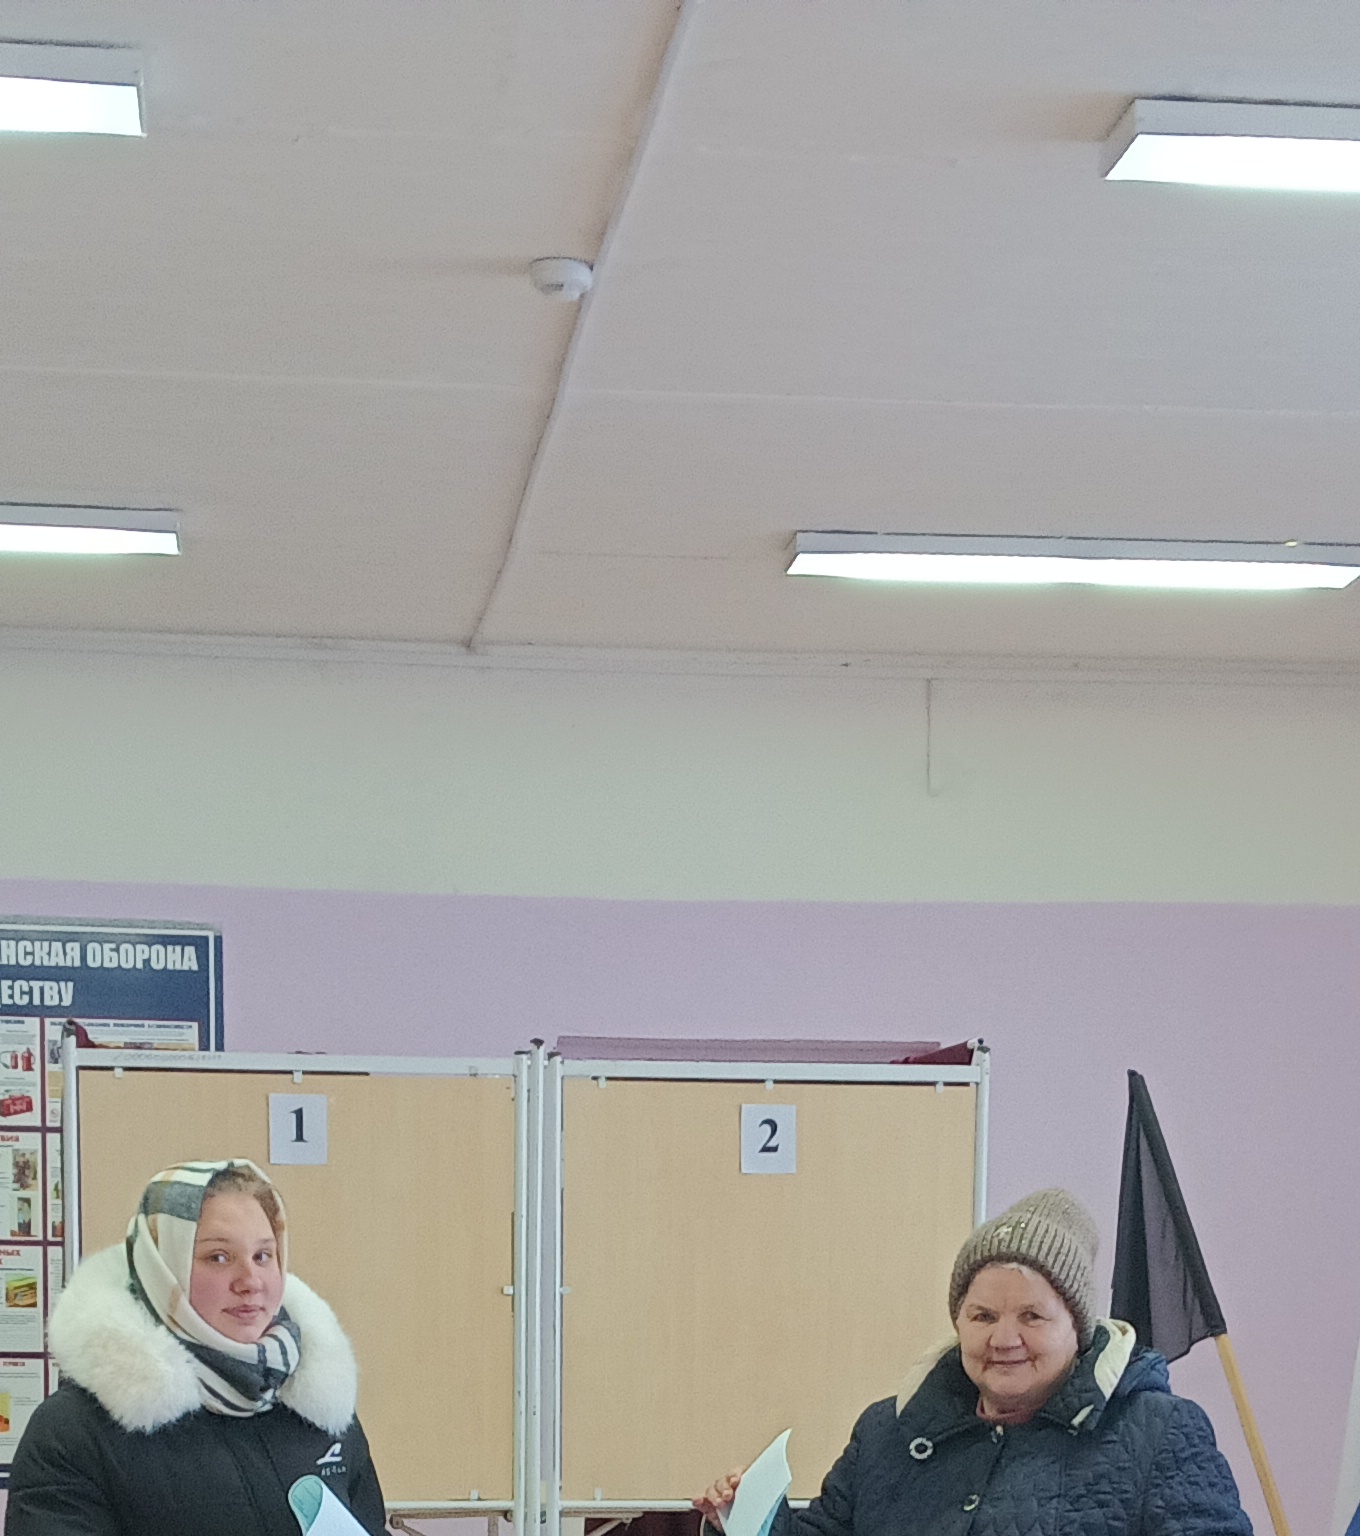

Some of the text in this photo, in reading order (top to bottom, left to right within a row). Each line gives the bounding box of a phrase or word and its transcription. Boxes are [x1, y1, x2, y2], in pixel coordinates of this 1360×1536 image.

[86, 942, 199, 971] ОБОРОНА
[289, 1106, 308, 1144] 1
[758, 1117, 781, 1154] 2
